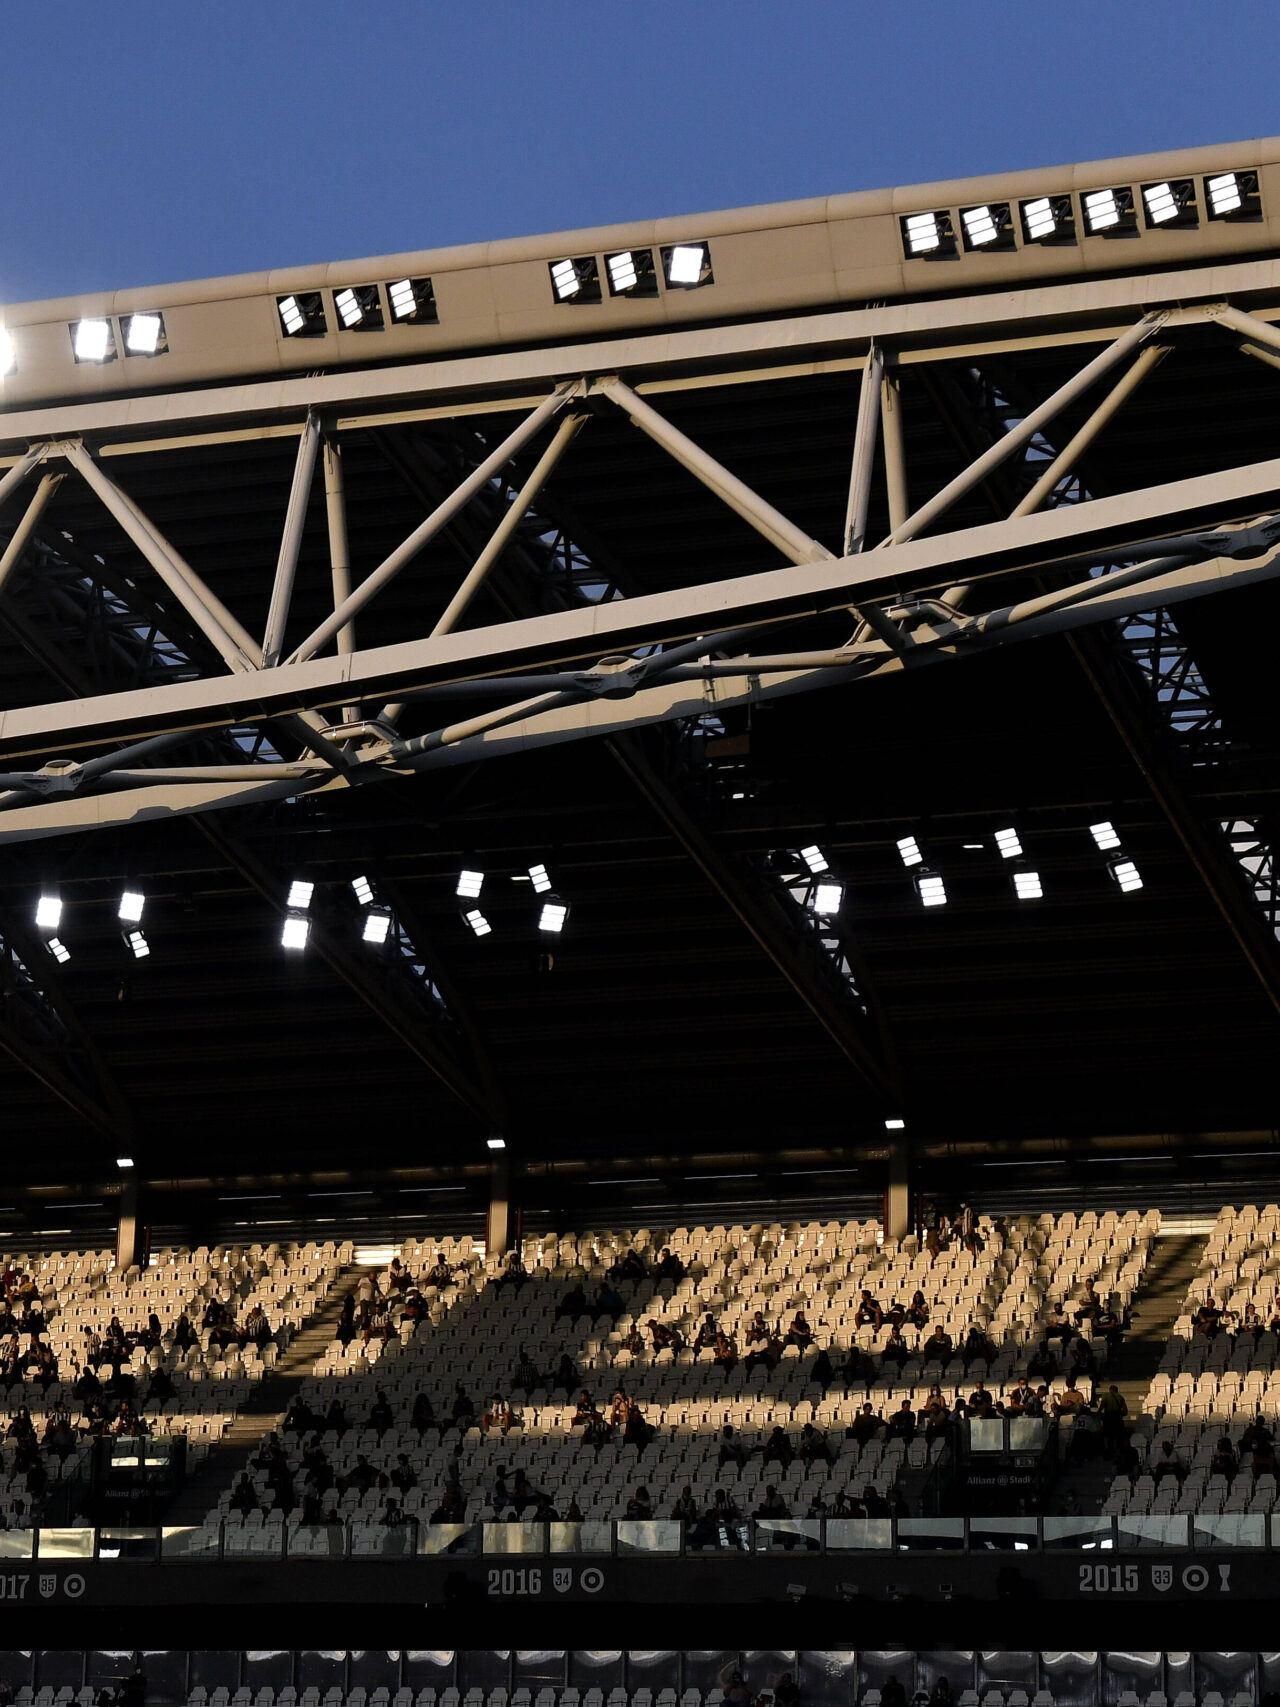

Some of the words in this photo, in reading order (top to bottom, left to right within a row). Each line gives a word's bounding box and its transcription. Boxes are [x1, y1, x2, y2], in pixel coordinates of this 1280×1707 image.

[41, 1578, 55, 1592] 35
[487, 1568, 542, 1595] 2016
[555, 1572, 569, 1586] 34
[1079, 1564, 1139, 1592] 2015
[1154, 1570, 1170, 1585] 33
